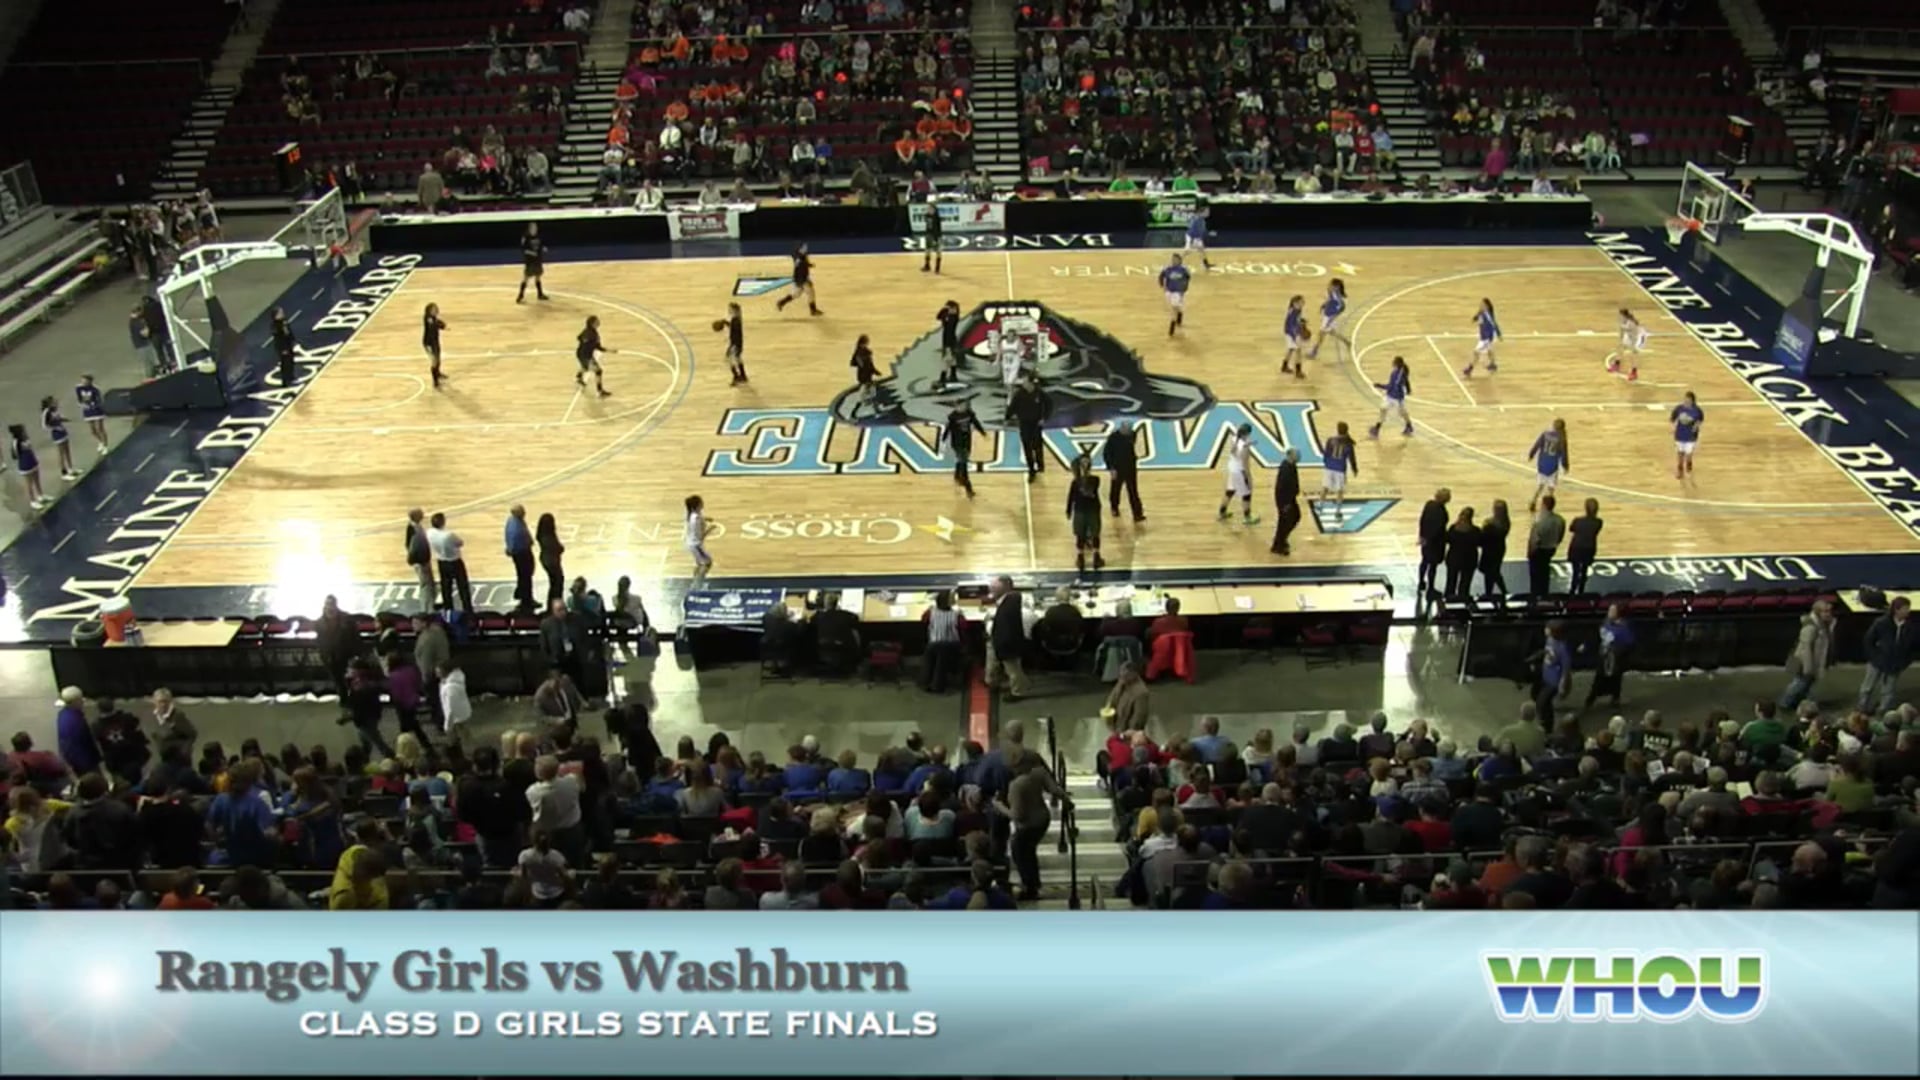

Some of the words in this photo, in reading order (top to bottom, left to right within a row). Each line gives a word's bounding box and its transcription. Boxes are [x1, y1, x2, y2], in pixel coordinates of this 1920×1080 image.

[902, 233, 1115, 250] BANGOR
[1585, 231, 1712, 309] MAINE
[1686, 321, 1849, 425] BLACK
[1820, 442, 1920, 537] BEA
[26, 466, 230, 624] MAINE
[197, 341, 345, 449] BLACK
[312, 252, 424, 332] BEARS
[700, 400, 1326, 476] MAINE
[545, 522, 726, 543] CENTE
[740, 517, 913, 545] CROSS
